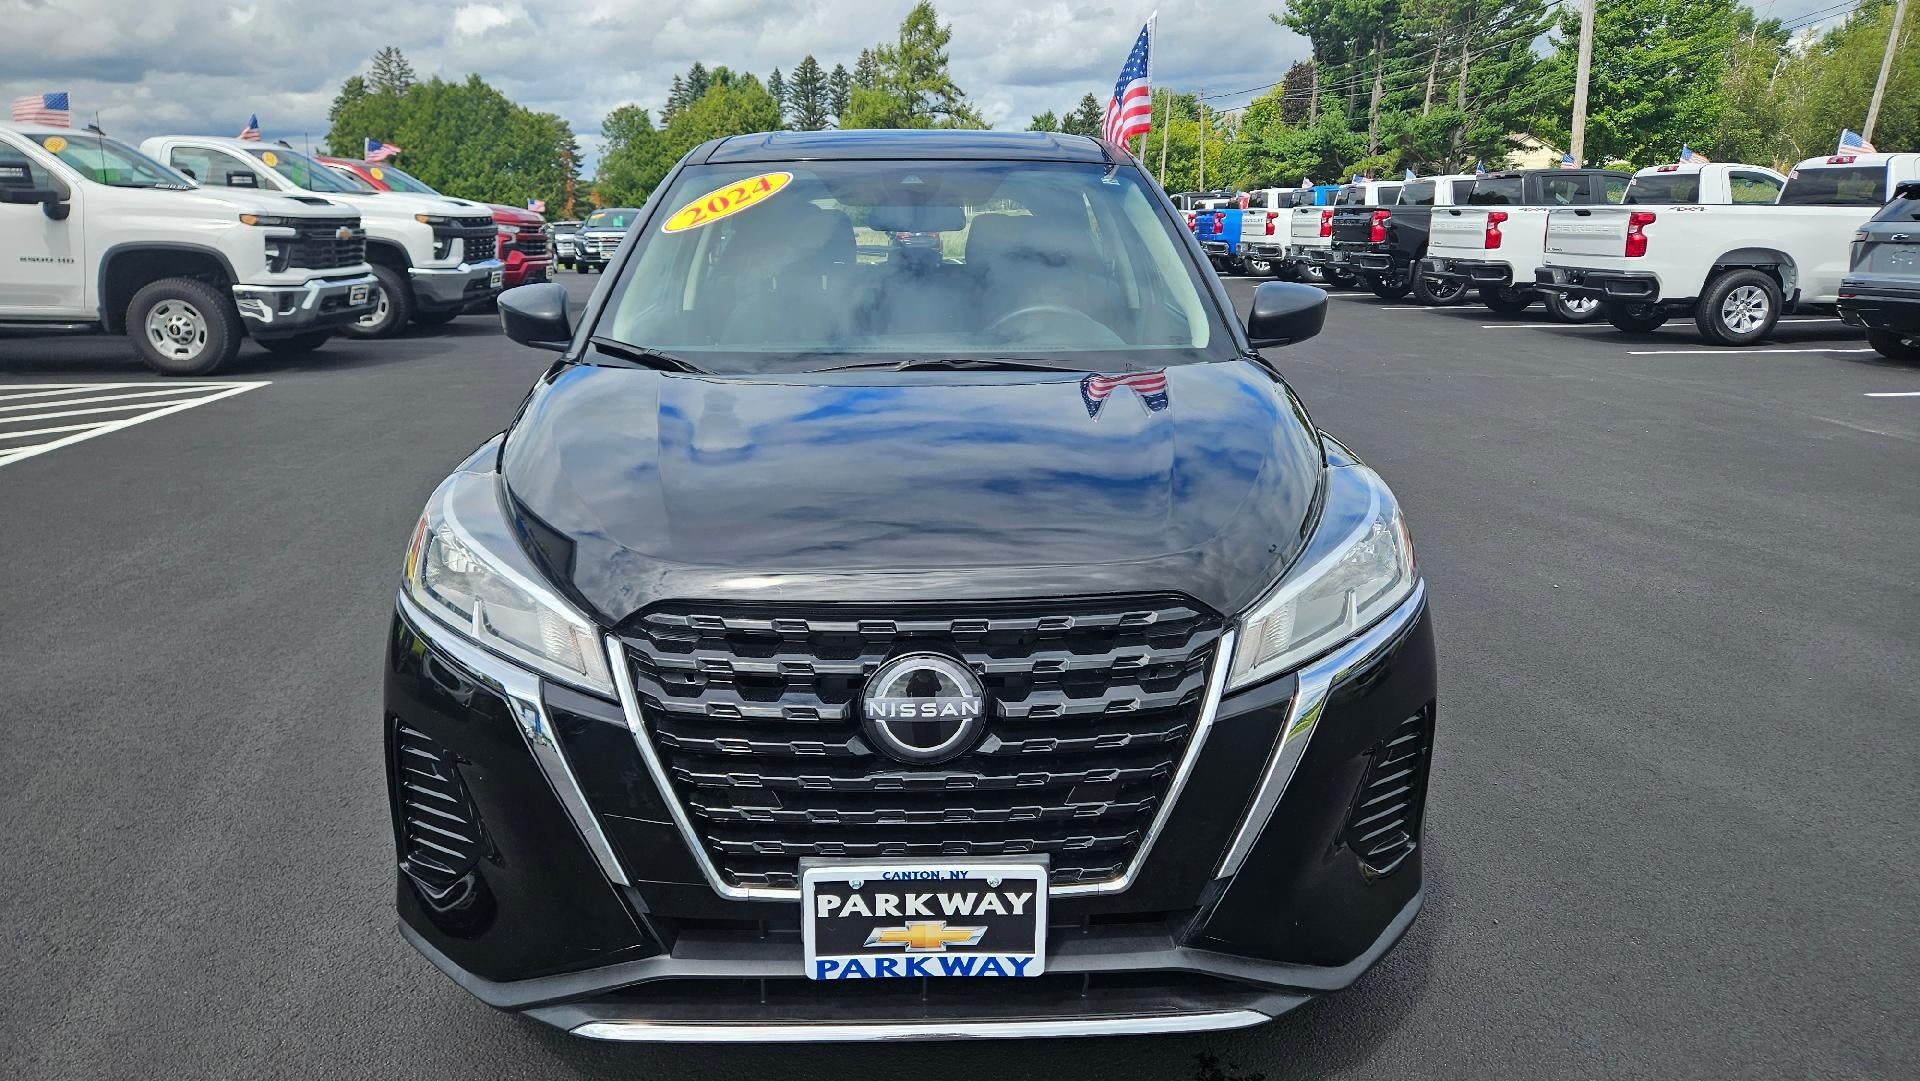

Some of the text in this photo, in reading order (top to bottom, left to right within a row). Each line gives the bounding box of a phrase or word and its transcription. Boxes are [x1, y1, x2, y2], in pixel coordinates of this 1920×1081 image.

[684, 176, 772, 225] 2024
[869, 701, 979, 718] NISSAN
[882, 871, 969, 883] CANTON, NY
[816, 892, 1033, 918] PARKWAY
[815, 956, 1034, 980] PARKWAY
